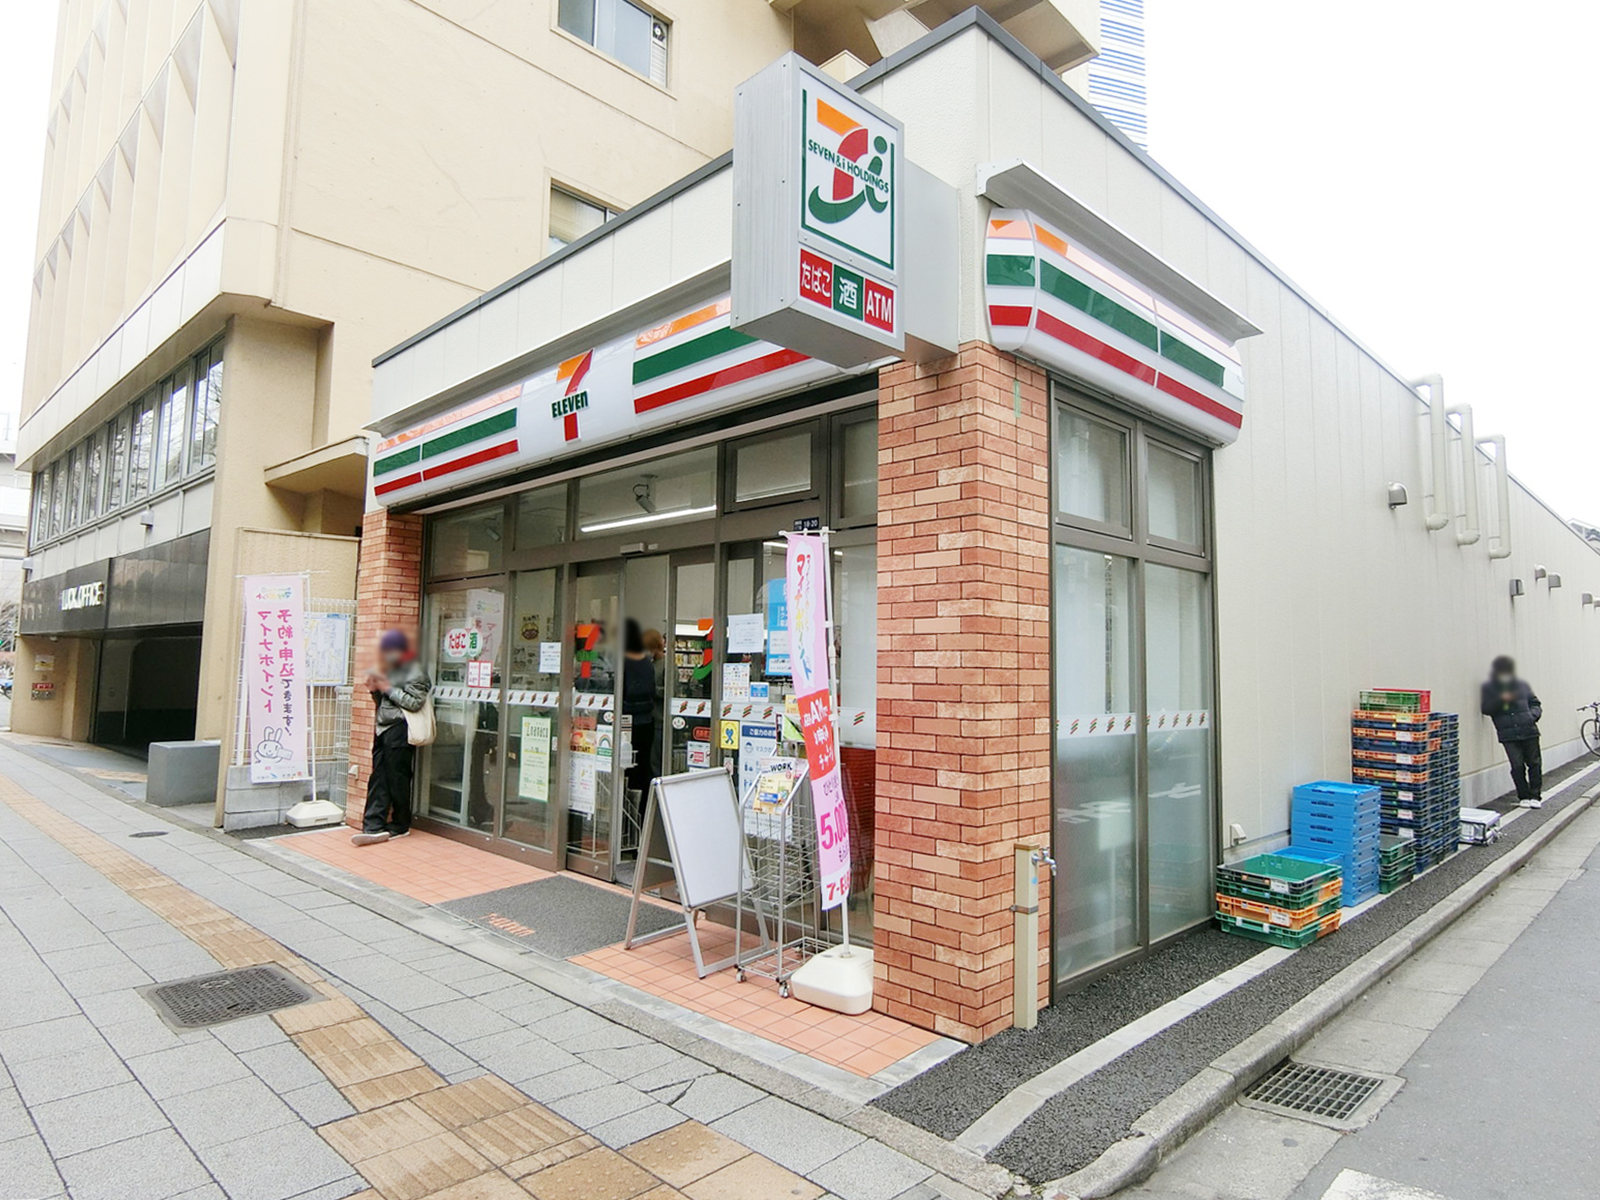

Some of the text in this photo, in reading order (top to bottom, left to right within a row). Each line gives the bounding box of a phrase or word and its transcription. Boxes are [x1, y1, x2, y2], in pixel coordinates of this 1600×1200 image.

[847, 160, 889, 194] HOLDINGS
[801, 260, 831, 298] たばこ
[839, 276, 858, 310] 酒
[866, 289, 892, 324] ATM
